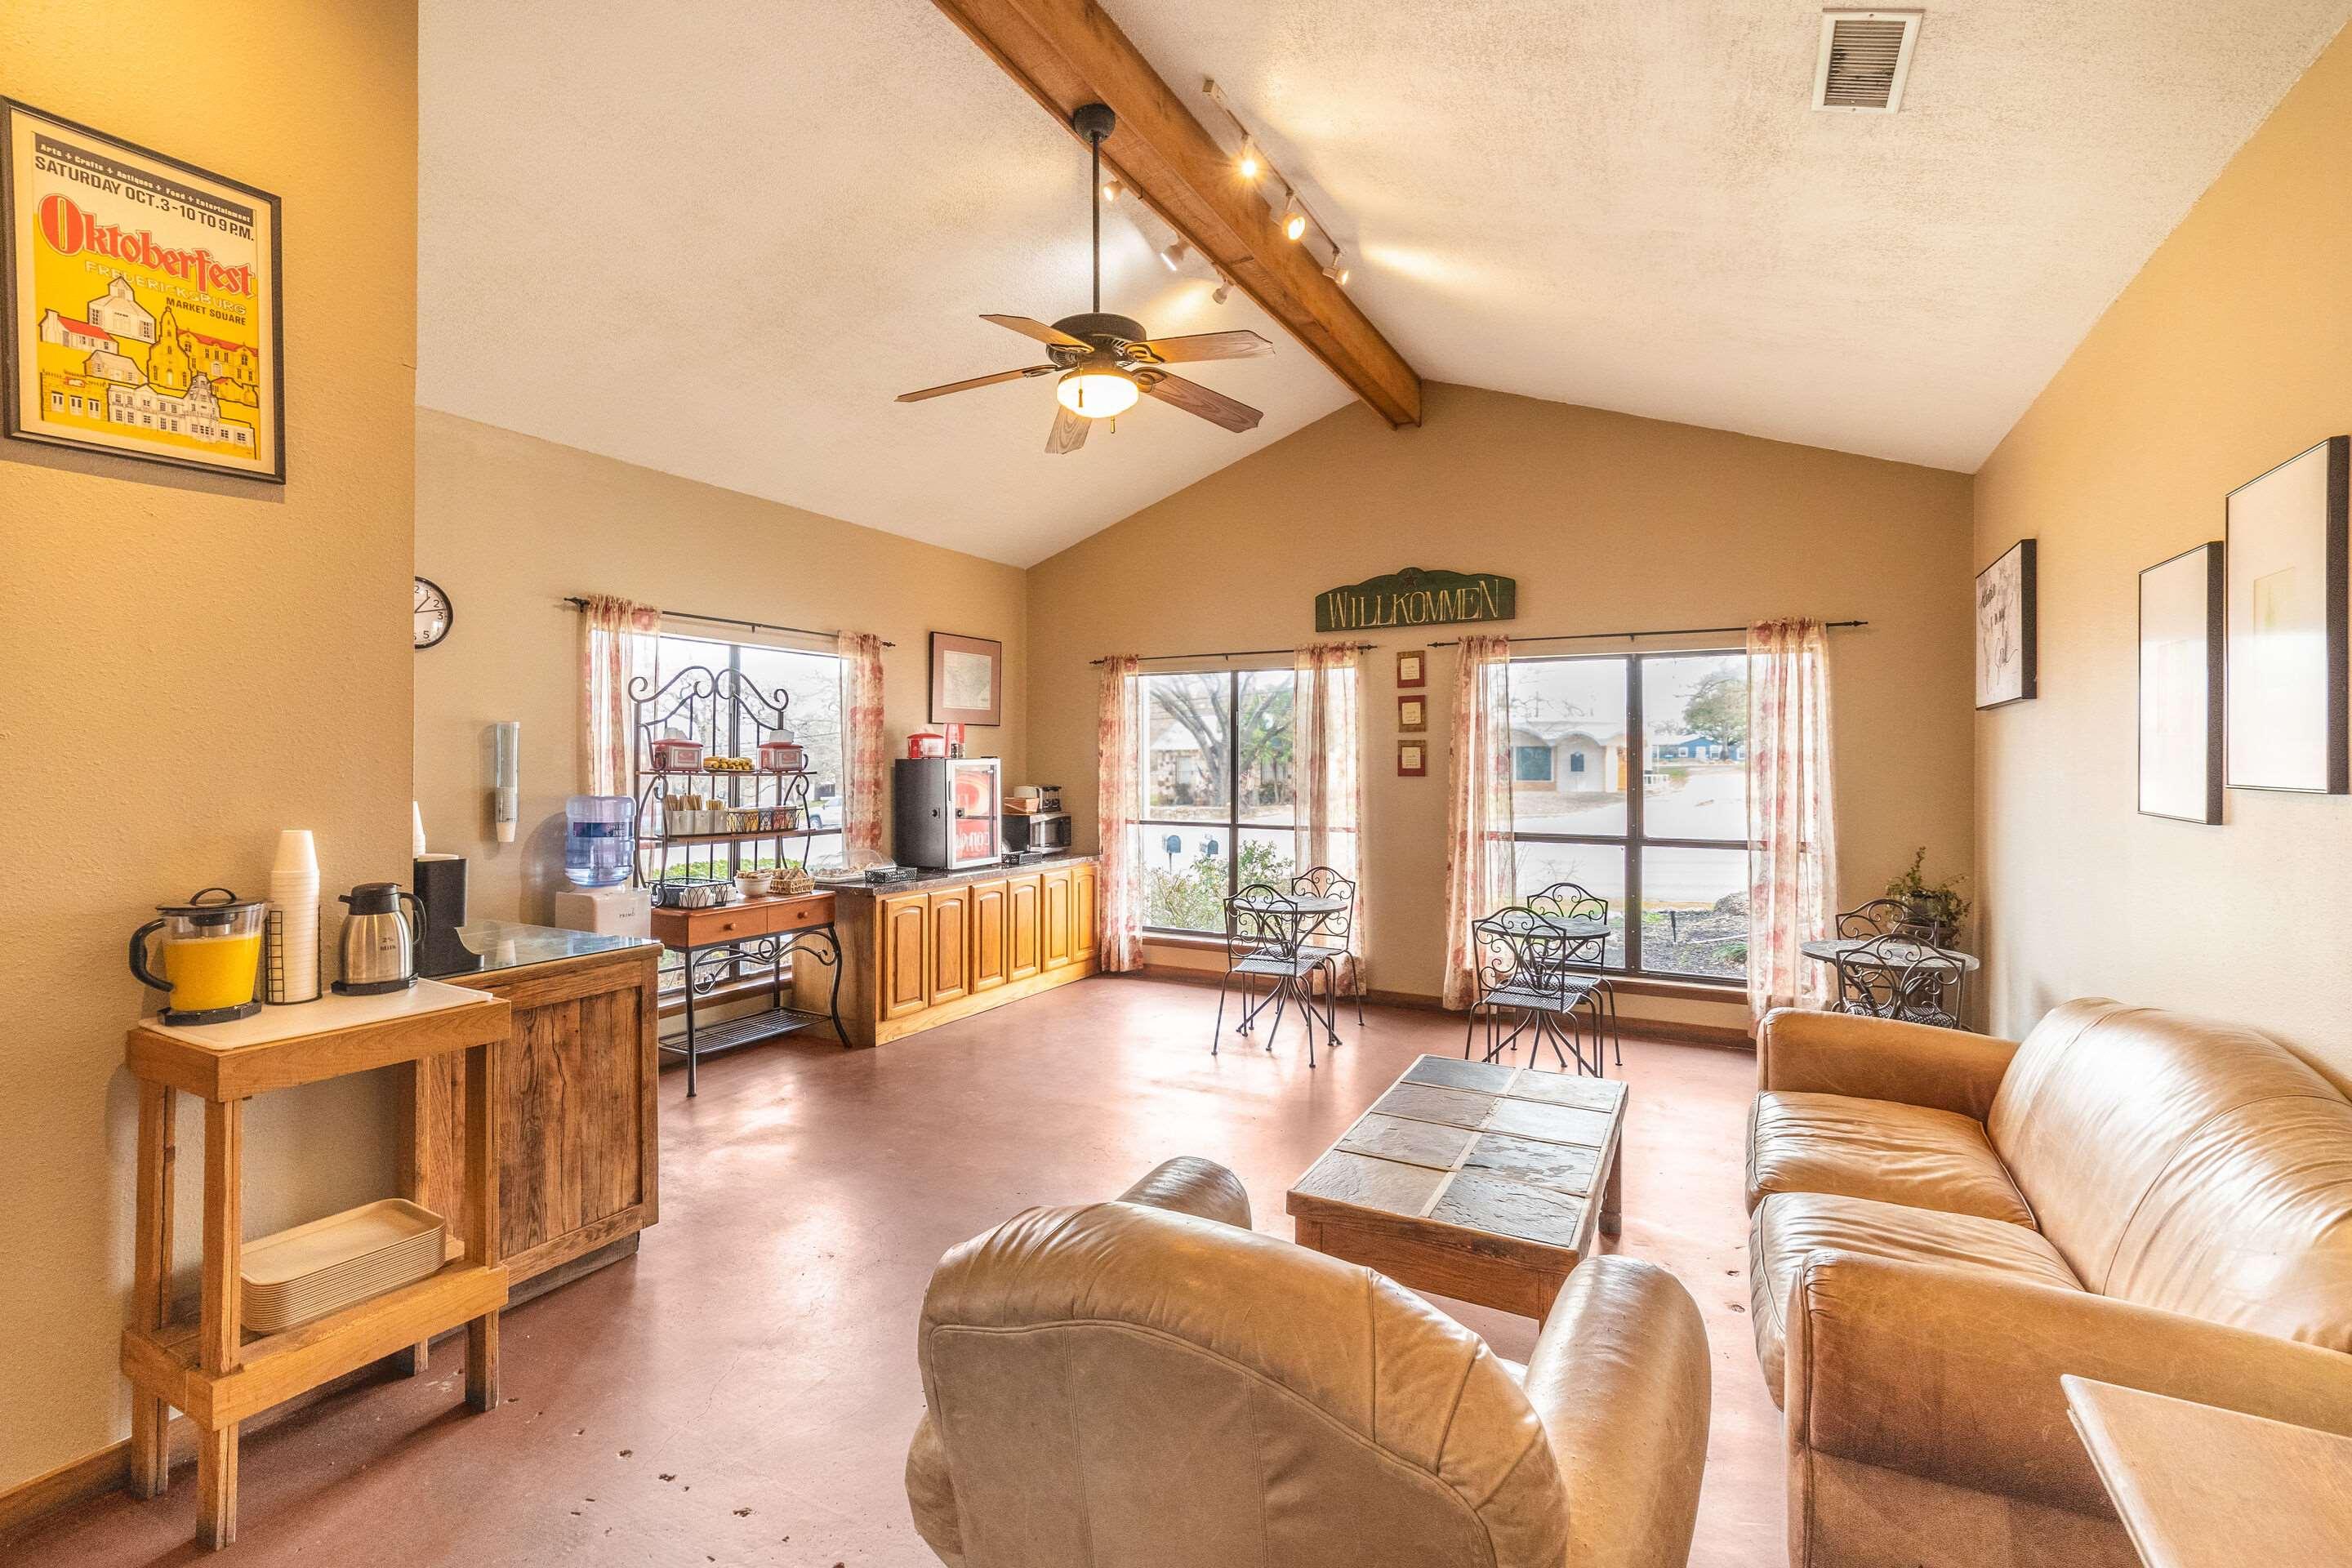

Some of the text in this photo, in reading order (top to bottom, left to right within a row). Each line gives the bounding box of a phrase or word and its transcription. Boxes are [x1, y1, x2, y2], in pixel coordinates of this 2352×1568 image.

[35, 156, 121, 194] SATURDAY
[198, 212, 216, 228] TO
[219, 219, 227, 231] 9
[40, 144, 62, 157] Arts
[74, 156, 104, 171] Crafts
[117, 170, 154, 189] Antiques
[166, 188, 186, 200] Food
[196, 198, 252, 223] Entertainment
[38, 194, 256, 297] Oktoberfest
[166, 297, 246, 326] MARKET SQUARE
[433, 599, 440, 608] 2
[437, 611, 443, 620] 3
[1328, 579, 1499, 628] WILLKOMMEN
[423, 630, 430, 639] 5
